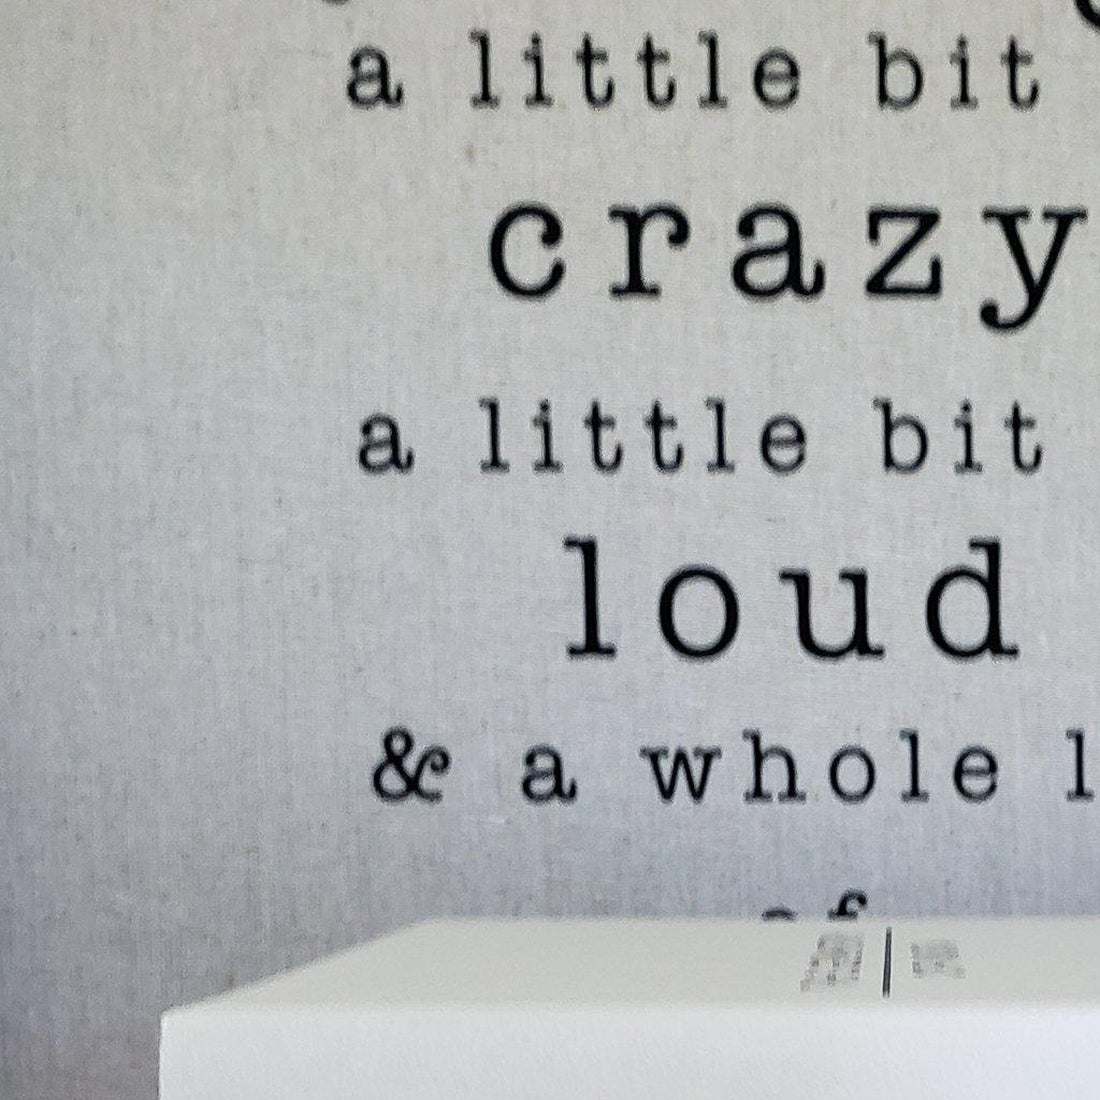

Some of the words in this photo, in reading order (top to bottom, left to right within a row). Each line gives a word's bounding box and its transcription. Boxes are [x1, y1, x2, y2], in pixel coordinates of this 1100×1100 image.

[345, 43, 404, 109] a
[470, 31, 802, 110] little
[868, 31, 1041, 111] bit
[489, 203, 1088, 333] crazy
[358, 410, 415, 475] a
[479, 398, 808, 475] little
[874, 398, 1042, 475] bit
[561, 534, 1019, 662] loud
[372, 726, 450, 802] &
[521, 743, 578, 802] a
[641, 728, 1000, 803] whole
